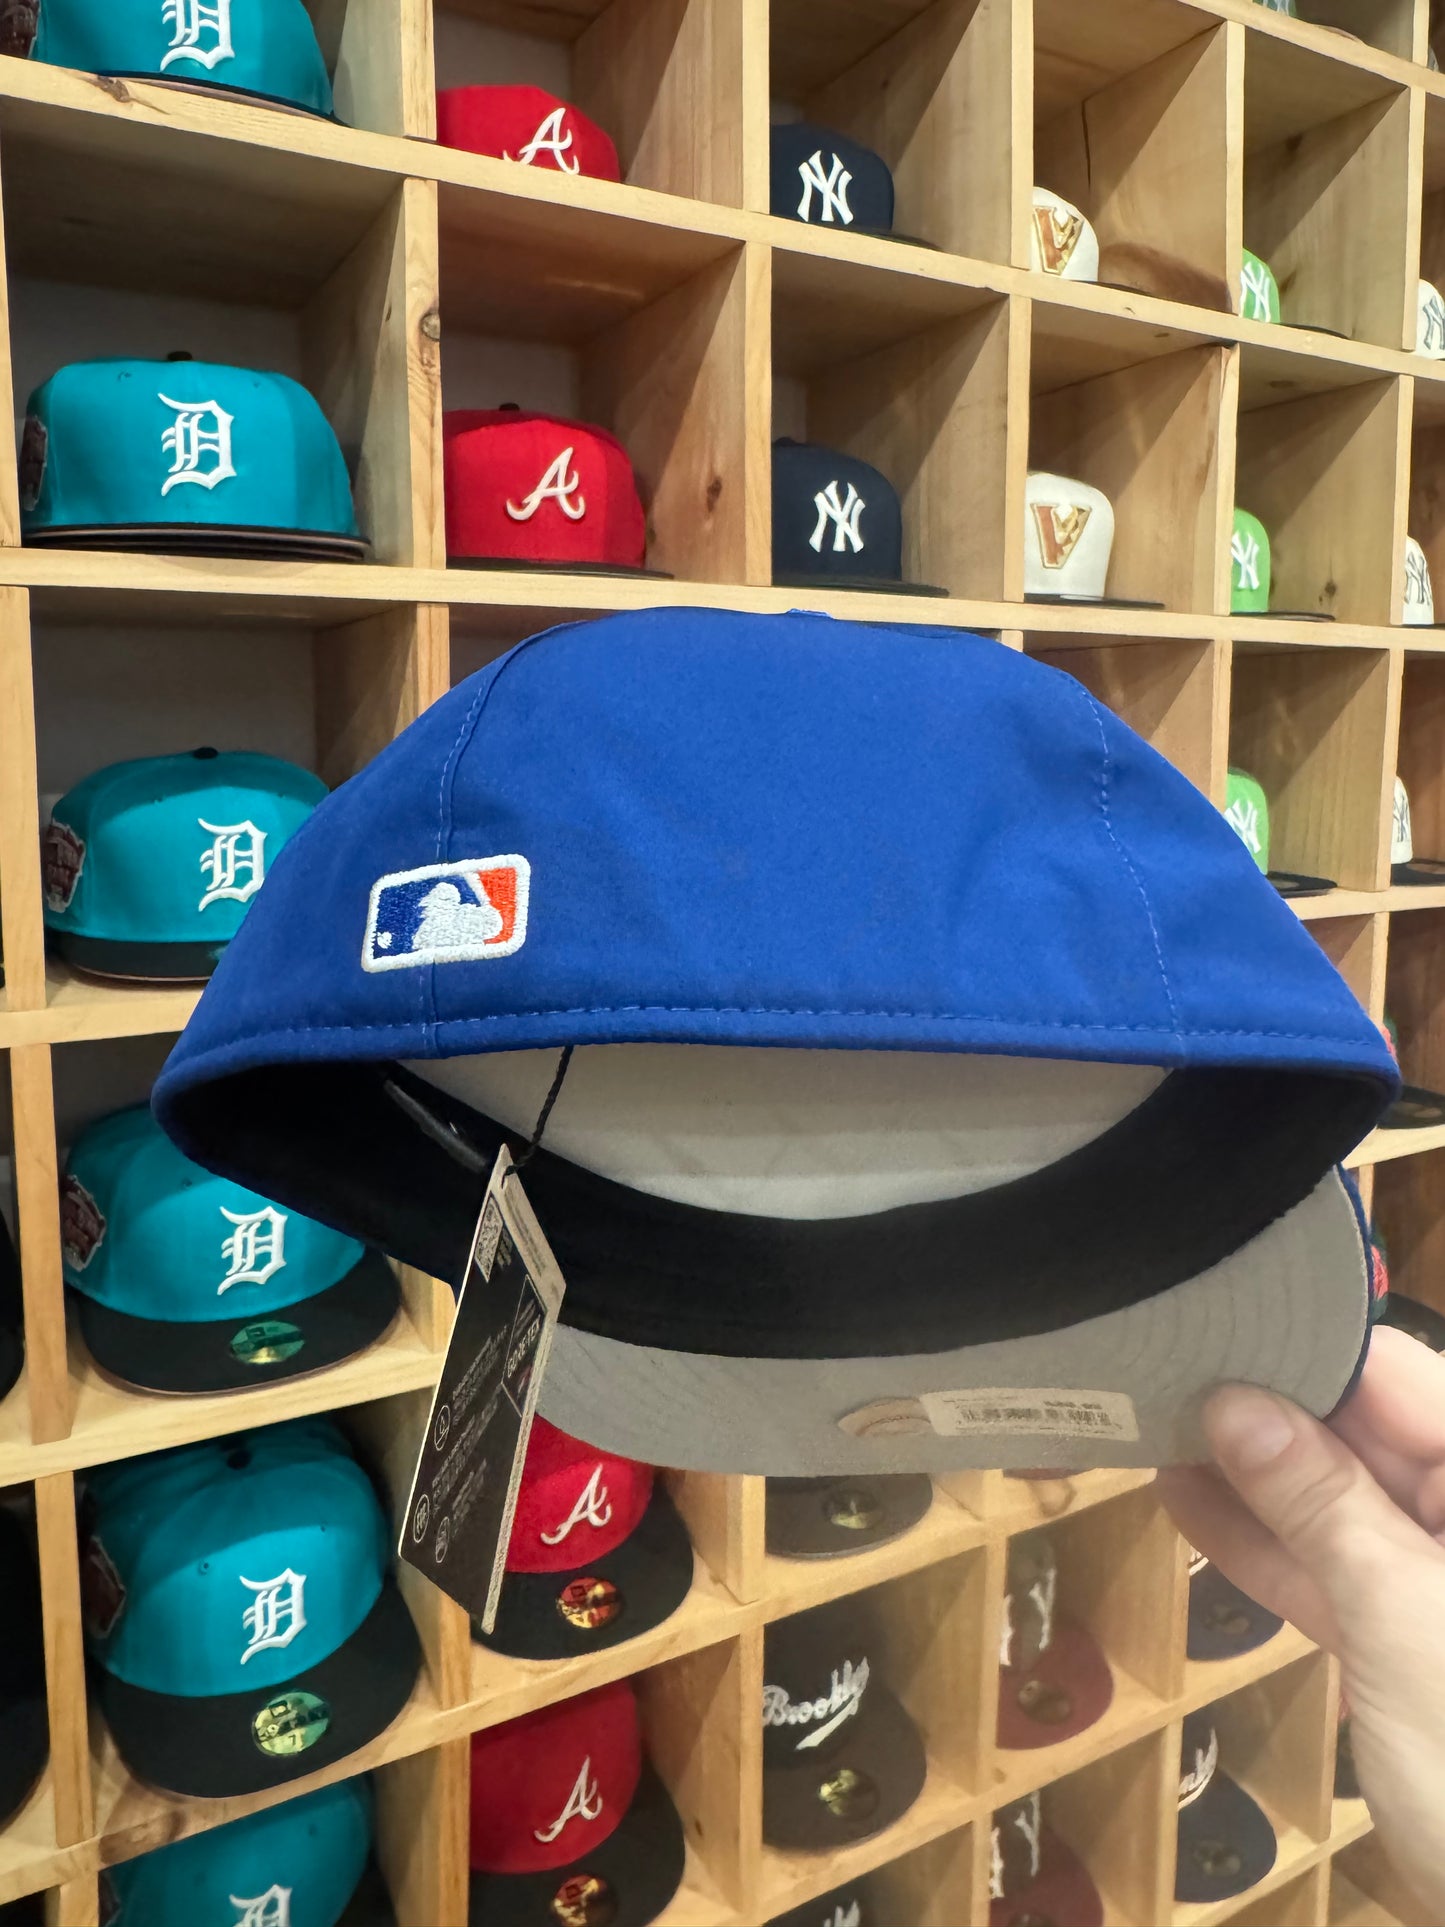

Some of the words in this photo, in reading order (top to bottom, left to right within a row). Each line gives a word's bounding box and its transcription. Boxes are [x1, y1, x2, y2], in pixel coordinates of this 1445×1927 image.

[160, 0, 235, 70] D
[502, 107, 580, 175] A
[797, 150, 854, 225] NY
[158, 393, 237, 497] D
[506, 446, 585, 521] A
[809, 480, 866, 553] NY
[1030, 503, 1092, 569] V
[198, 818, 266, 912] D
[217, 1205, 288, 1295] D
[540, 1463, 612, 1545] A
[239, 1567, 307, 1665] D
[535, 1757, 603, 1843] A
